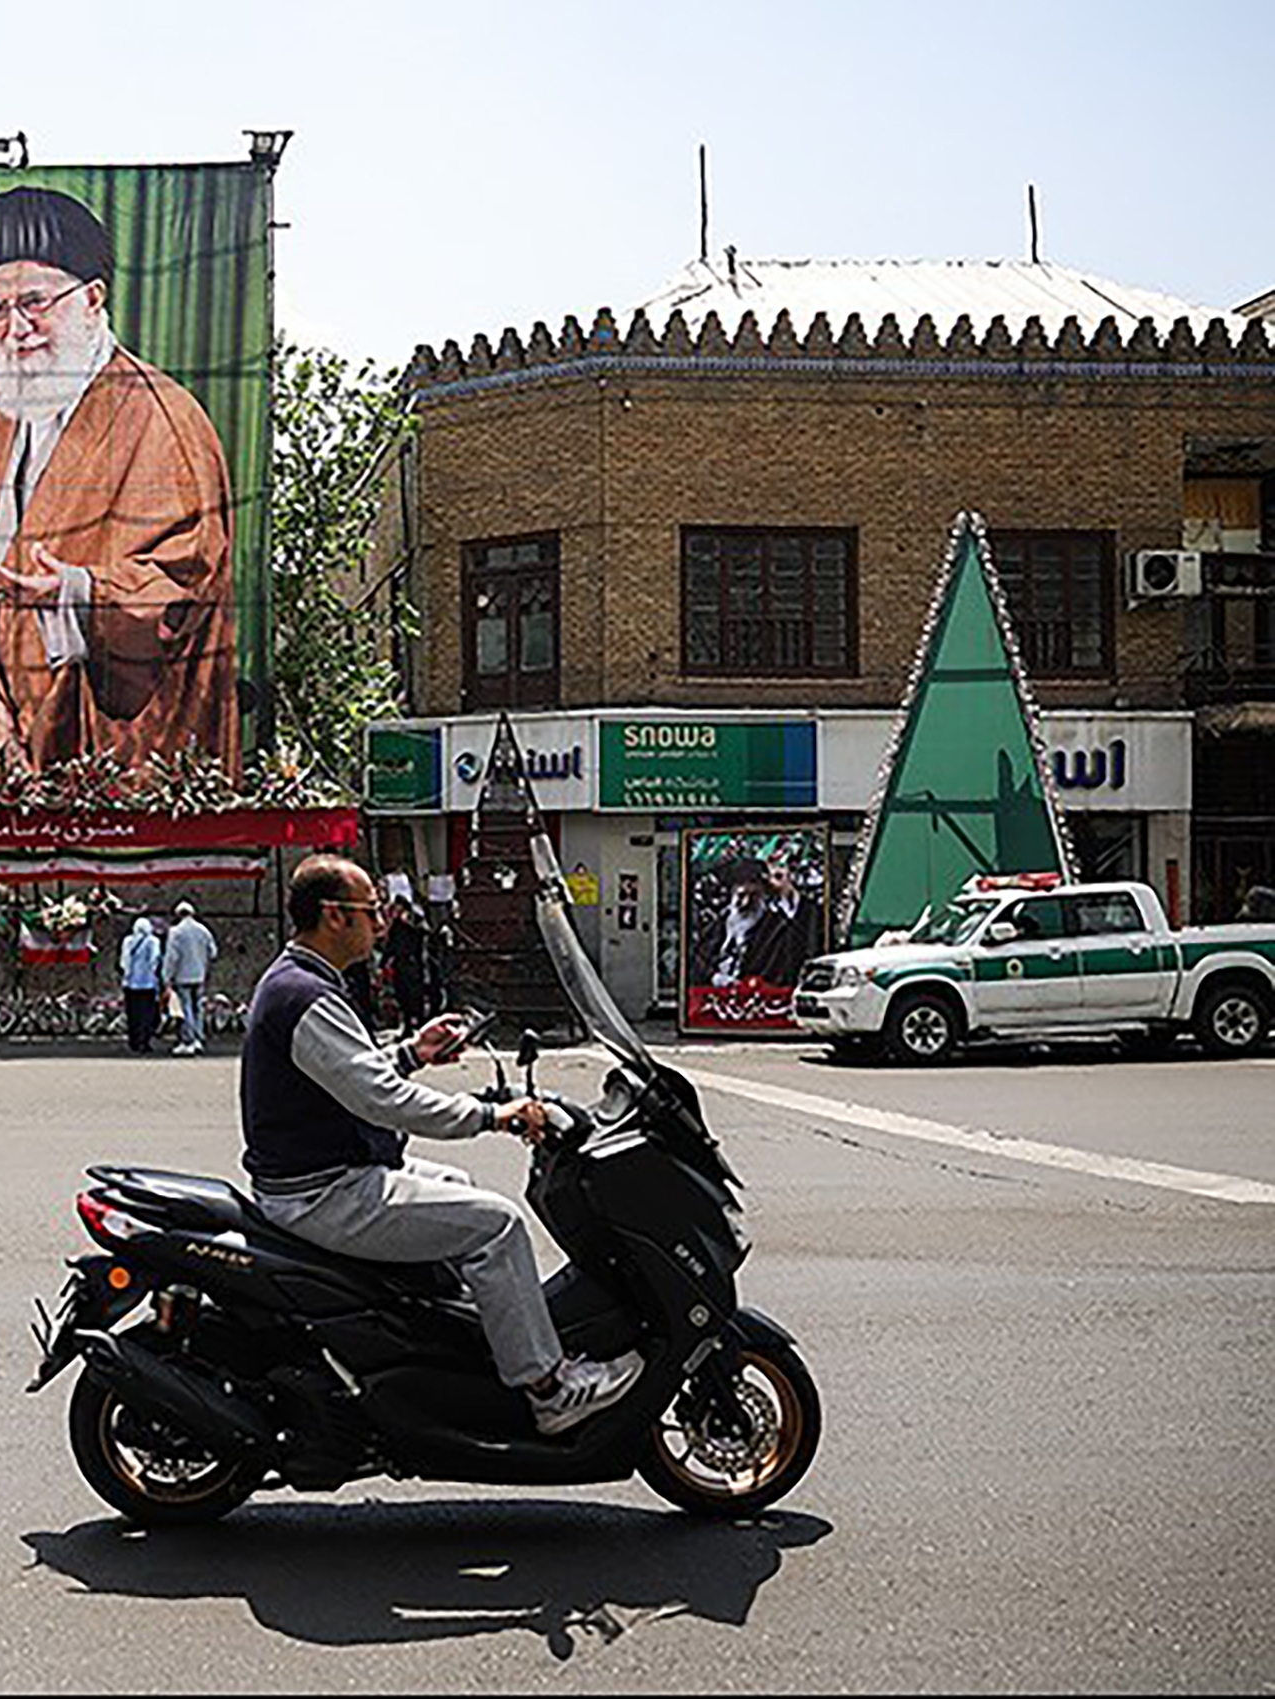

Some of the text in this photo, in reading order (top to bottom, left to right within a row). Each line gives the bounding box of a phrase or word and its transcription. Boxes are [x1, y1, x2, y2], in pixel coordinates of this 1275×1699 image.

[624, 725, 716, 747] snowa
[40, 820, 61, 843] به
[63, 816, 134, 842] معشوق
